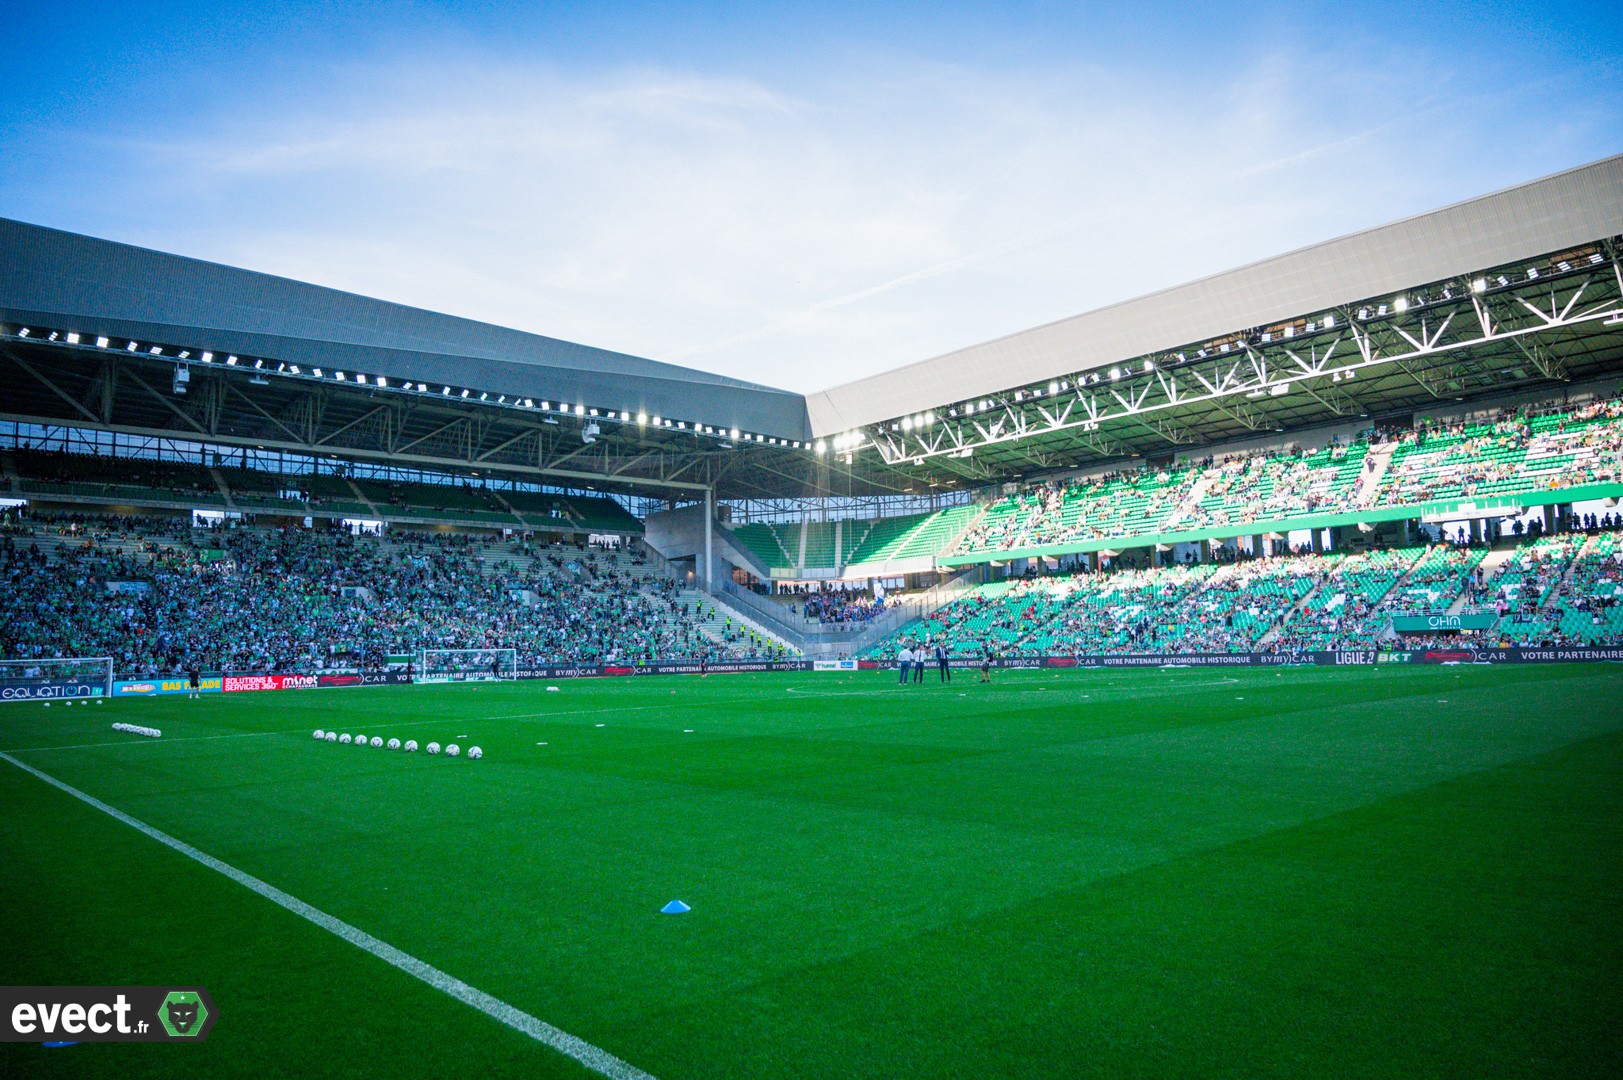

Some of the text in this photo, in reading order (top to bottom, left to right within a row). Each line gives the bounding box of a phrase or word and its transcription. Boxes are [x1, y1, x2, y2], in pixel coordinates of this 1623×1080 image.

[1207, 656, 1250, 664] HISTORIQUE
[1335, 652, 1375, 664] LIGUE 2
[1377, 653, 1412, 662] BKT
[1521, 651, 1555, 660] VOTRE
[162, 681, 181, 690] BAS
[225, 683, 260, 691] SERVICES
